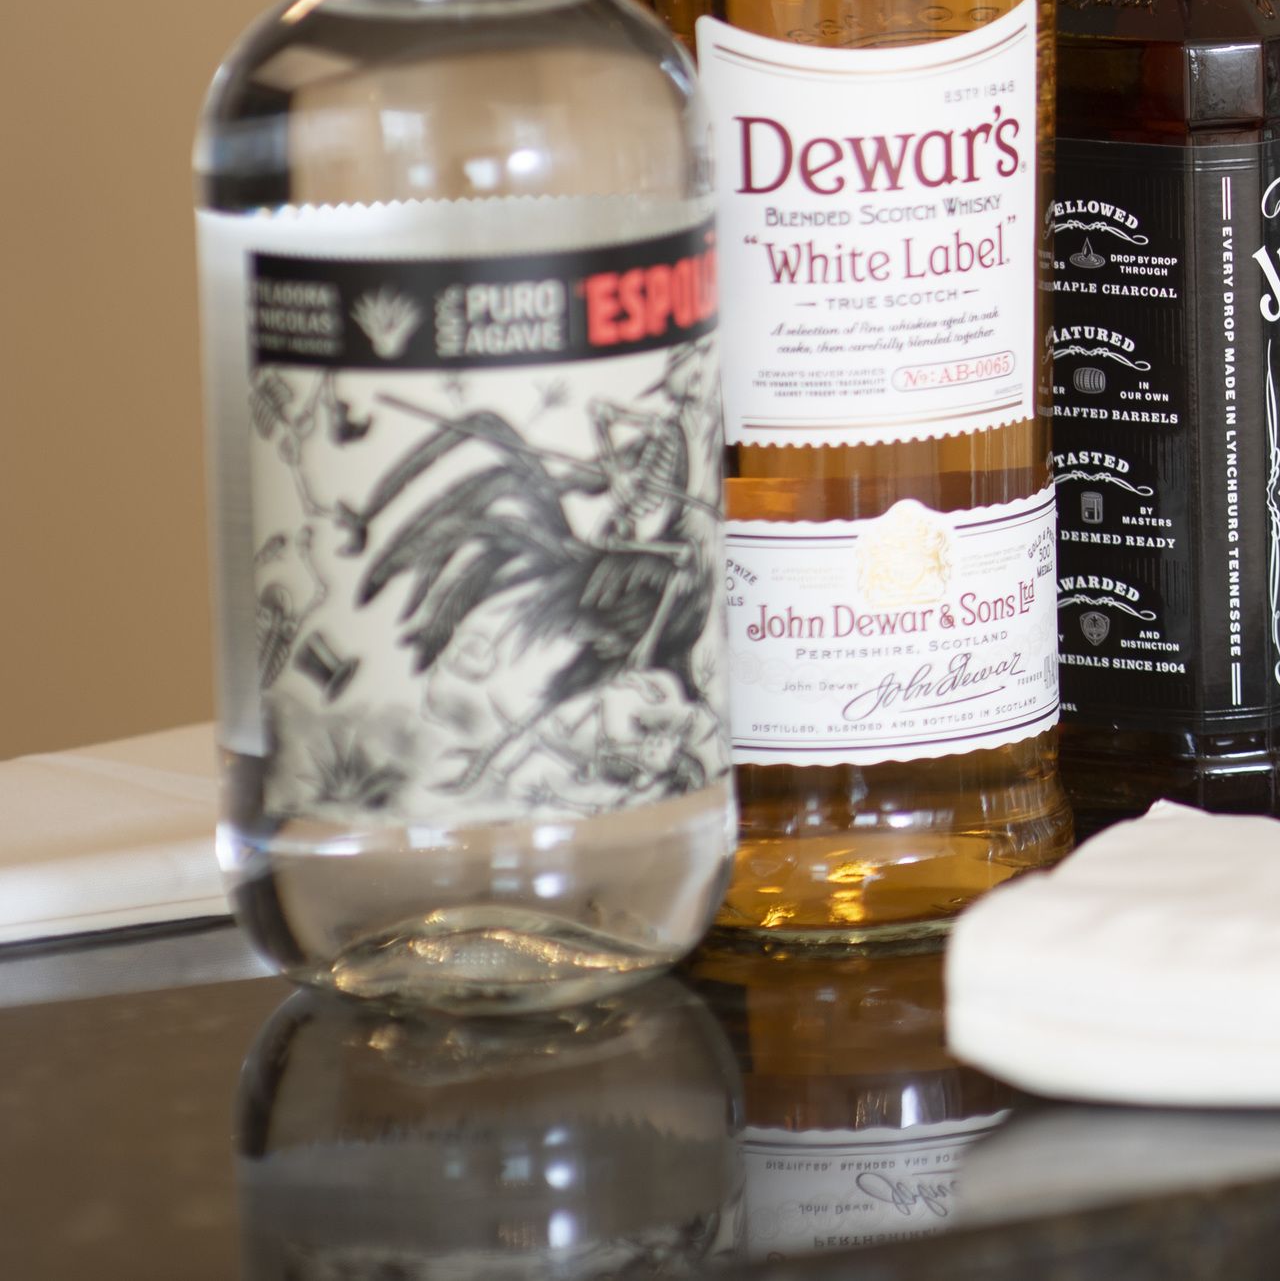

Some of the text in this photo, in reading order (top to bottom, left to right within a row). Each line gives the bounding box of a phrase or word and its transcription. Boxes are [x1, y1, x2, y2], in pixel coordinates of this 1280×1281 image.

[733, 105, 1019, 195] Dewar's
[765, 194, 1003, 227] BLENDED SCOTCH WHISKY
[1110, 253, 1178, 266] DROP BY DROP
[1119, 265, 1168, 276] THROUGH
[466, 278, 566, 321] PURO
[826, 289, 959, 310] TRUE SCOTCH
[1101, 284, 1178, 299] CHARCOAL
[770, 307, 999, 336] A selection of fine whiskies aged in oak
[465, 320, 566, 355] AGAVE
[816, 340, 846, 353] then
[849, 337, 904, 352] carefully
[907, 332, 952, 347] blended
[1138, 381, 1150, 390] IN
[1120, 391, 1169, 402] OUR OWN
[1050, 405, 1178, 424] RAFTED BARRELS
[1222, 226, 1241, 657] EVERY DROP MADE IN LYNCHBURG TENNESSEE
[1053, 451, 1130, 474] TASTED
[1140, 506, 1153, 515] BY
[1122, 516, 1172, 527] MASTERS
[1060, 529, 1176, 549] DEEMED READY
[726, 559, 758, 585] PRIZE
[747, 578, 1036, 641] John Dewar & Sons Ltd
[928, 631, 1009, 653] SCOTLAND
[1139, 630, 1160, 639] AND
[1120, 639, 1180, 652] DISTINCTION
[1112, 659, 1153, 672] SINCE
[1155, 661, 1186, 674] 1904
[782, 680, 859, 692] John Dewar
[842, 663, 934, 722] John
[933, 651, 1027, 697] Dewar
[826, 722, 883, 733] BLENDED
[891, 719, 916, 730] AND
[922, 712, 976, 726] BOTTLED
[979, 709, 991, 719] IN
[995, 697, 1038, 716] SCOTLAND
